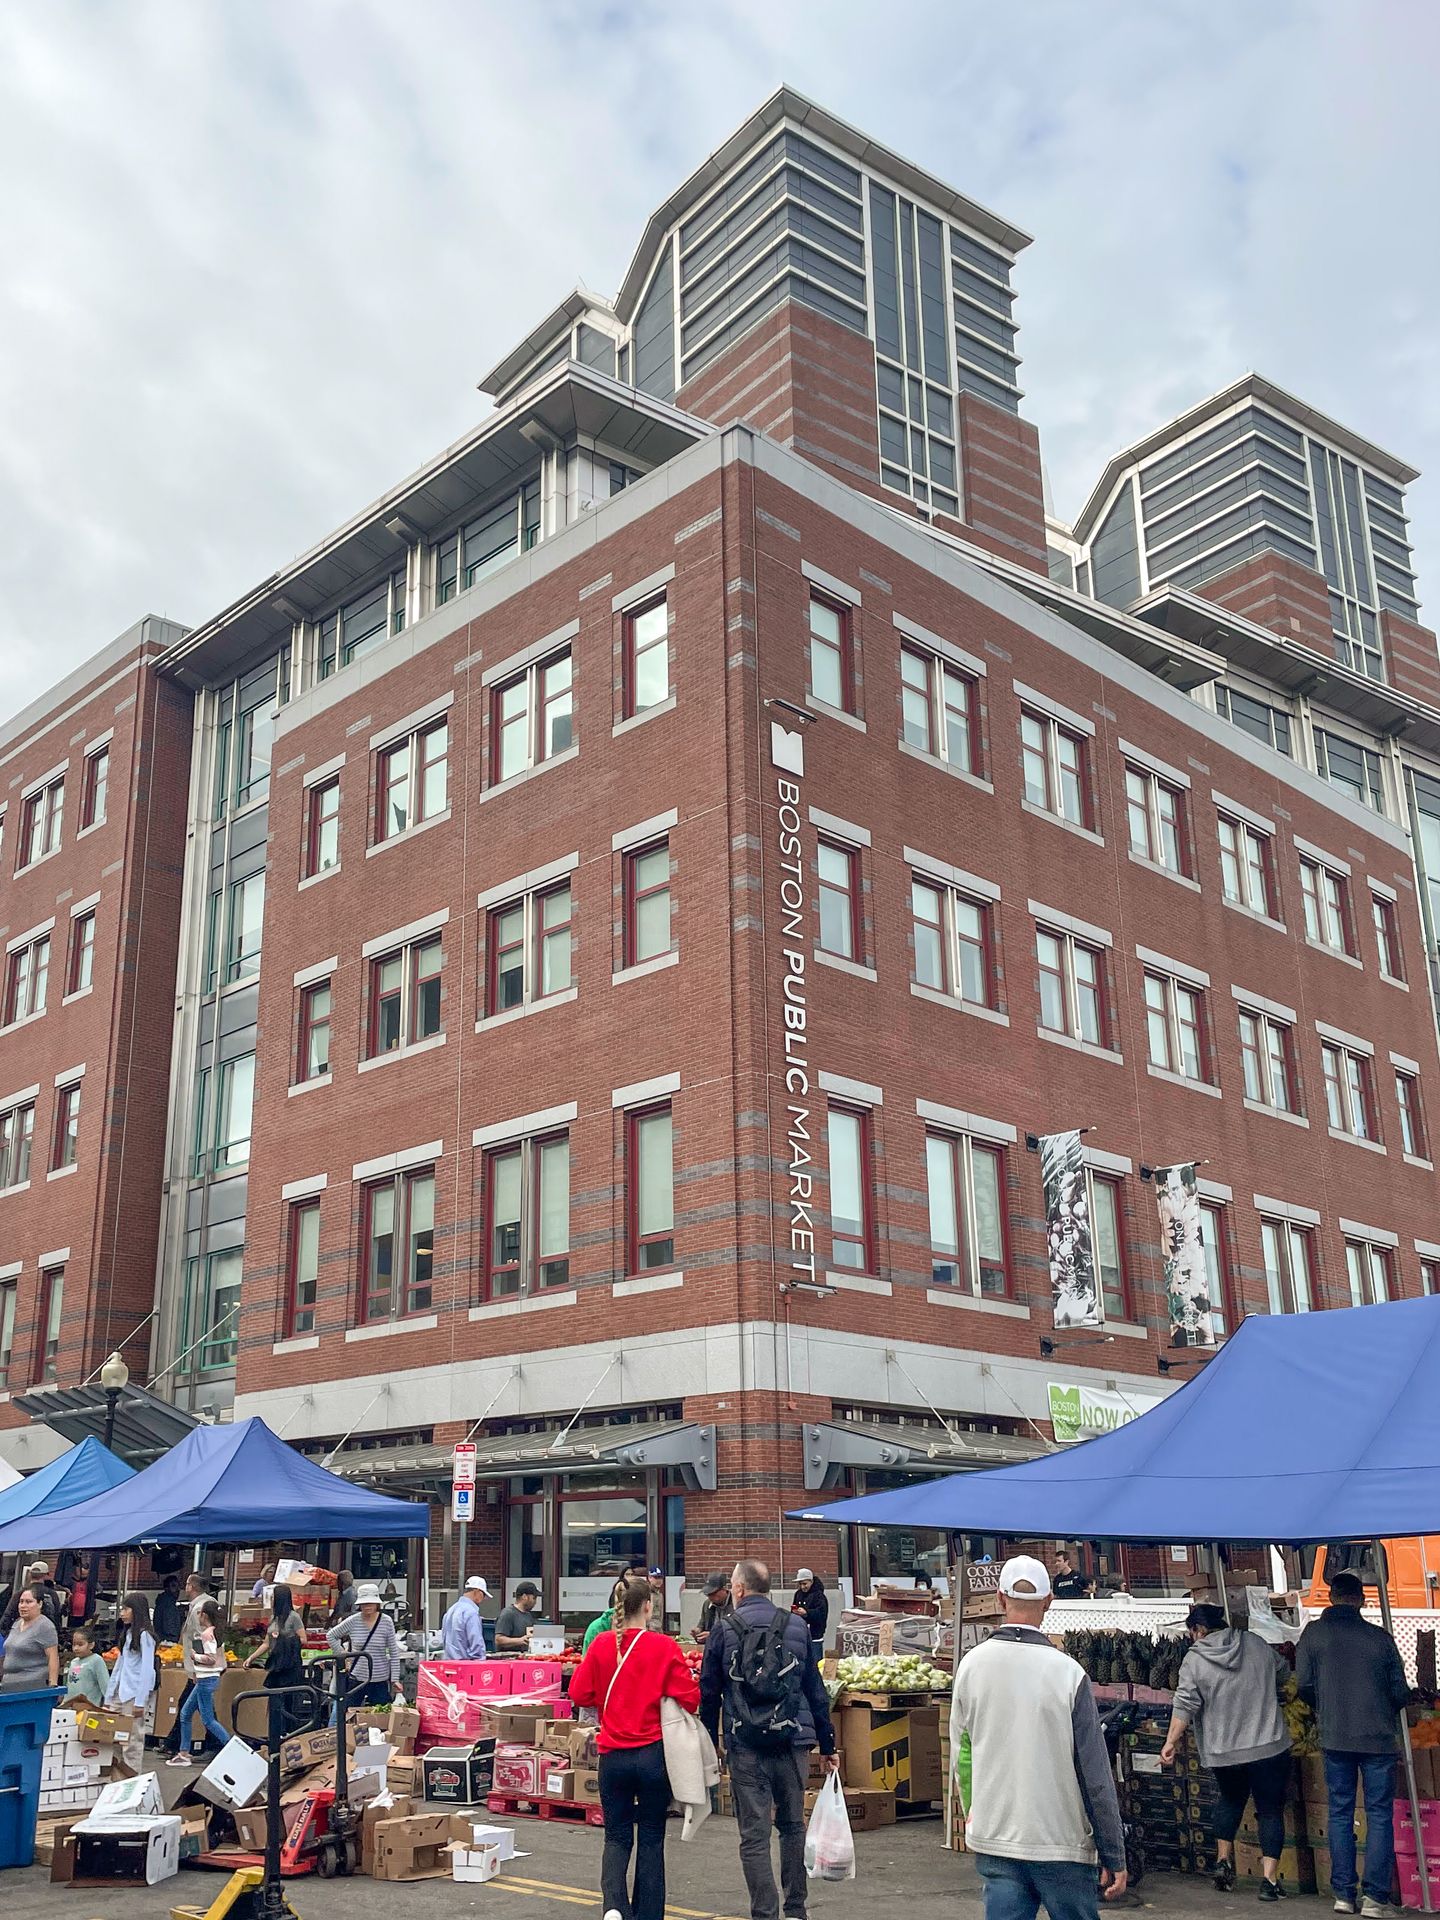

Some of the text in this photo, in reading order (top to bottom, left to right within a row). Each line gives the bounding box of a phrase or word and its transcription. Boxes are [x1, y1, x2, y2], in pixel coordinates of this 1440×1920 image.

[777, 778, 816, 1283] BOSTON PUBLIC MARKET
[1082, 1404, 1119, 1430] NOW
[967, 1565, 1001, 1578] COKE
[843, 1631, 875, 1646] COKE
[843, 1642, 874, 1657] FARM
